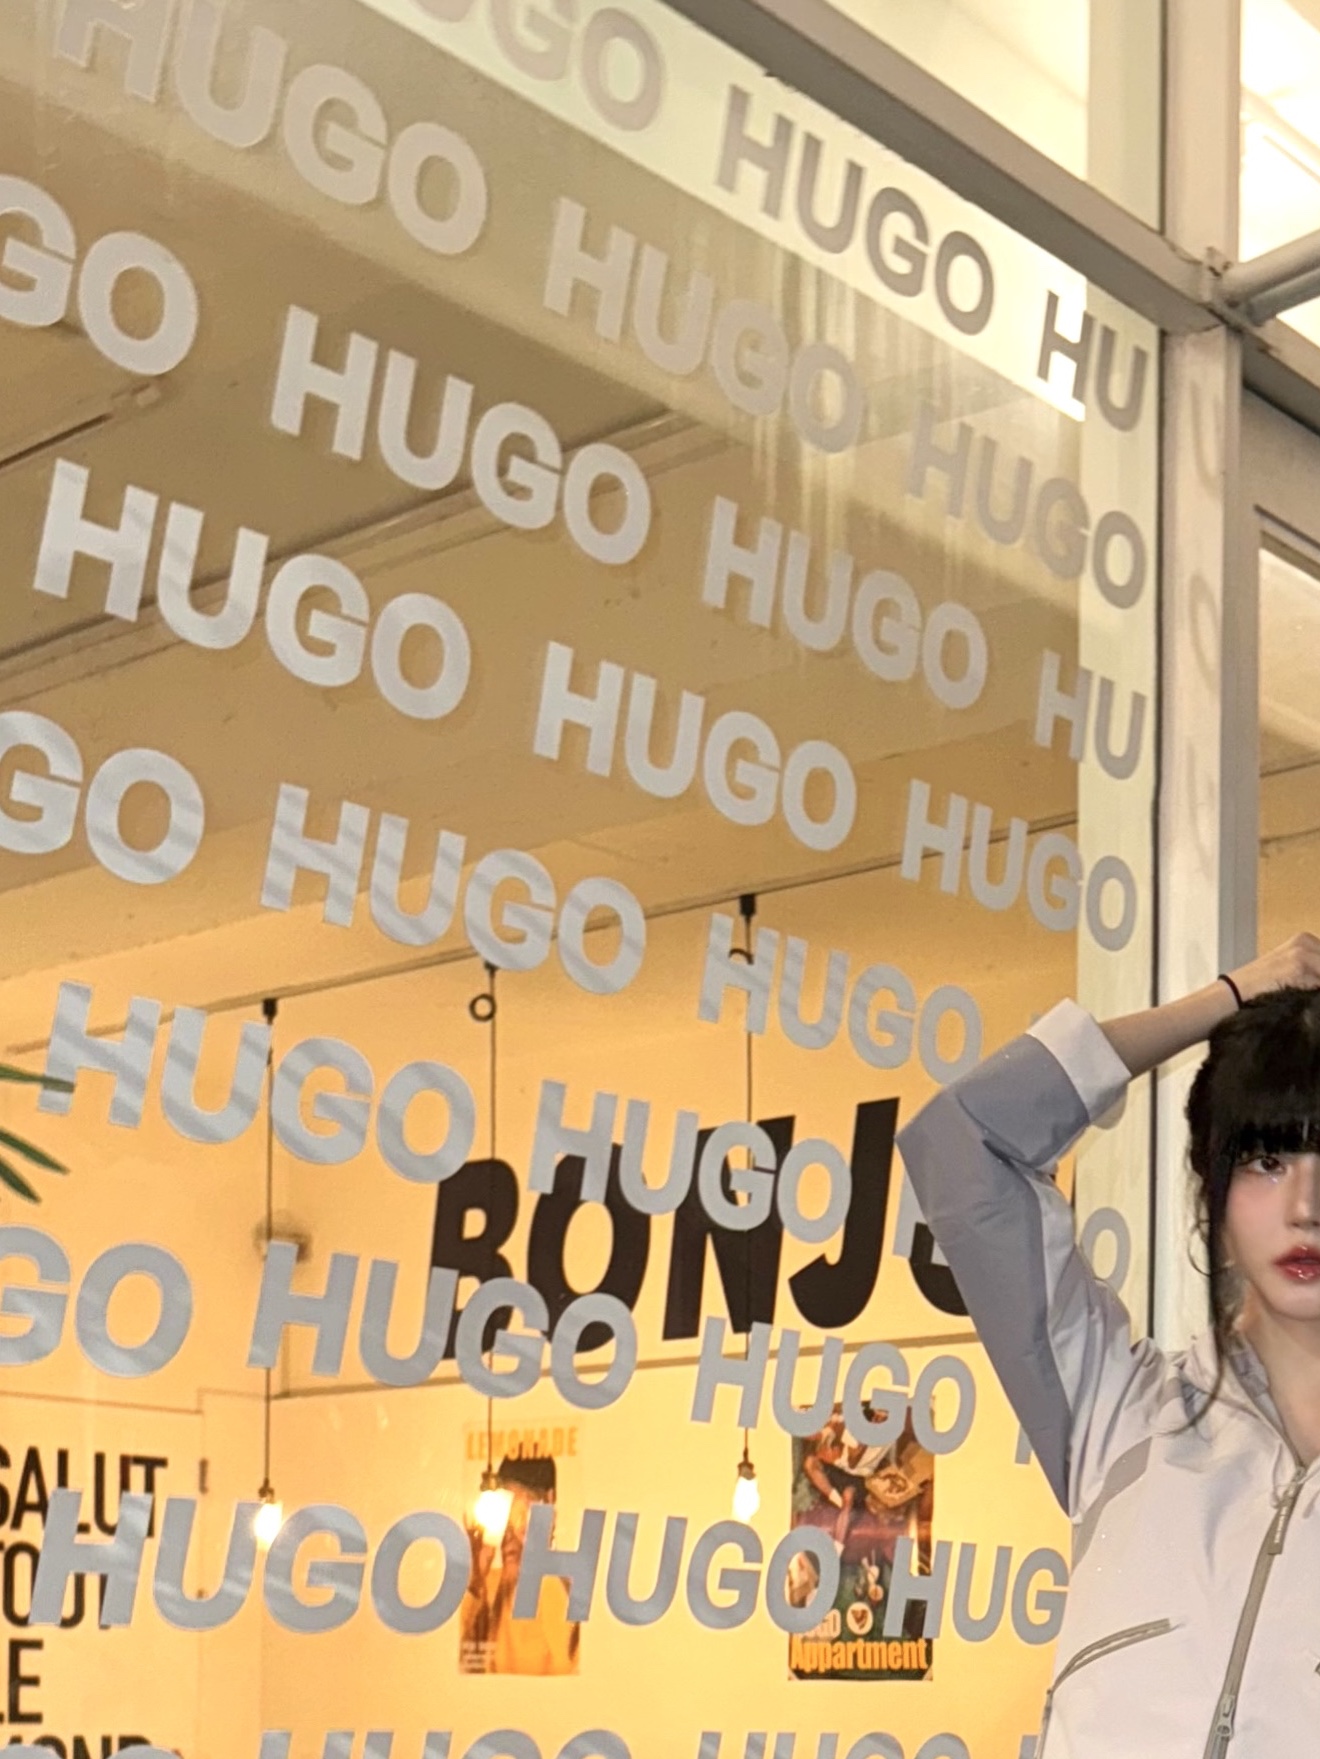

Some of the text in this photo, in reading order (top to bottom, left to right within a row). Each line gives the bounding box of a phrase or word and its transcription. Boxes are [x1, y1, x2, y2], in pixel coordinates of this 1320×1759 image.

[543, 196, 863, 454] HUGO
[903, 402, 1148, 611] HUGO
[714, 83, 995, 336] HUGO
[1037, 290, 1148, 433] HU
[270, 303, 651, 565] HUGO
[702, 494, 989, 710] HUGO
[1034, 648, 1148, 781] HU
[32, 457, 1138, 952] HUGO HUGO HUGO
[260, 783, 647, 995] HUGO
[697, 912, 984, 1087] HUGO
[37, 980, 477, 1184] HUGO
[527, 1078, 853, 1244] HUGO
[246, 1238, 638, 1410] HUGO
[690, 1316, 977, 1456] HUGO
[28, 1487, 1070, 1645] HUGO HUGO HUG
[790, 1637, 929, 1673] Appartment
